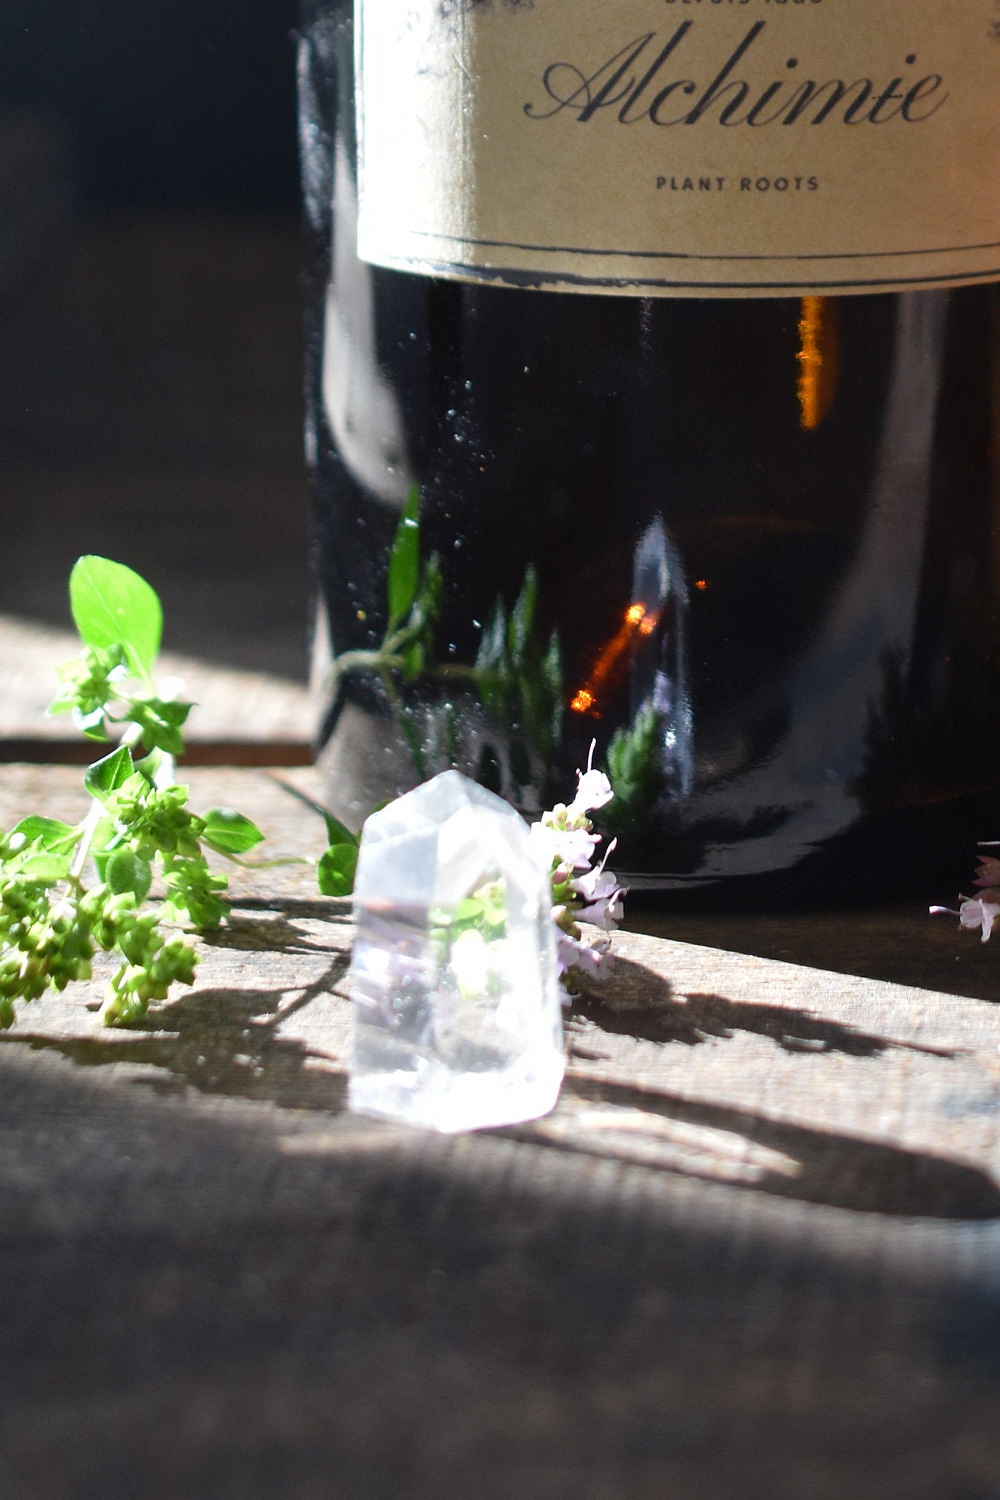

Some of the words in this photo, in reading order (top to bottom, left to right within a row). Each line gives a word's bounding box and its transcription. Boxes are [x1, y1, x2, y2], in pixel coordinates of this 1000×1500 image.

[523, 20, 950, 128] Alchimie
[656, 175, 726, 191] PLANT
[739, 176, 819, 192] ROOTS
